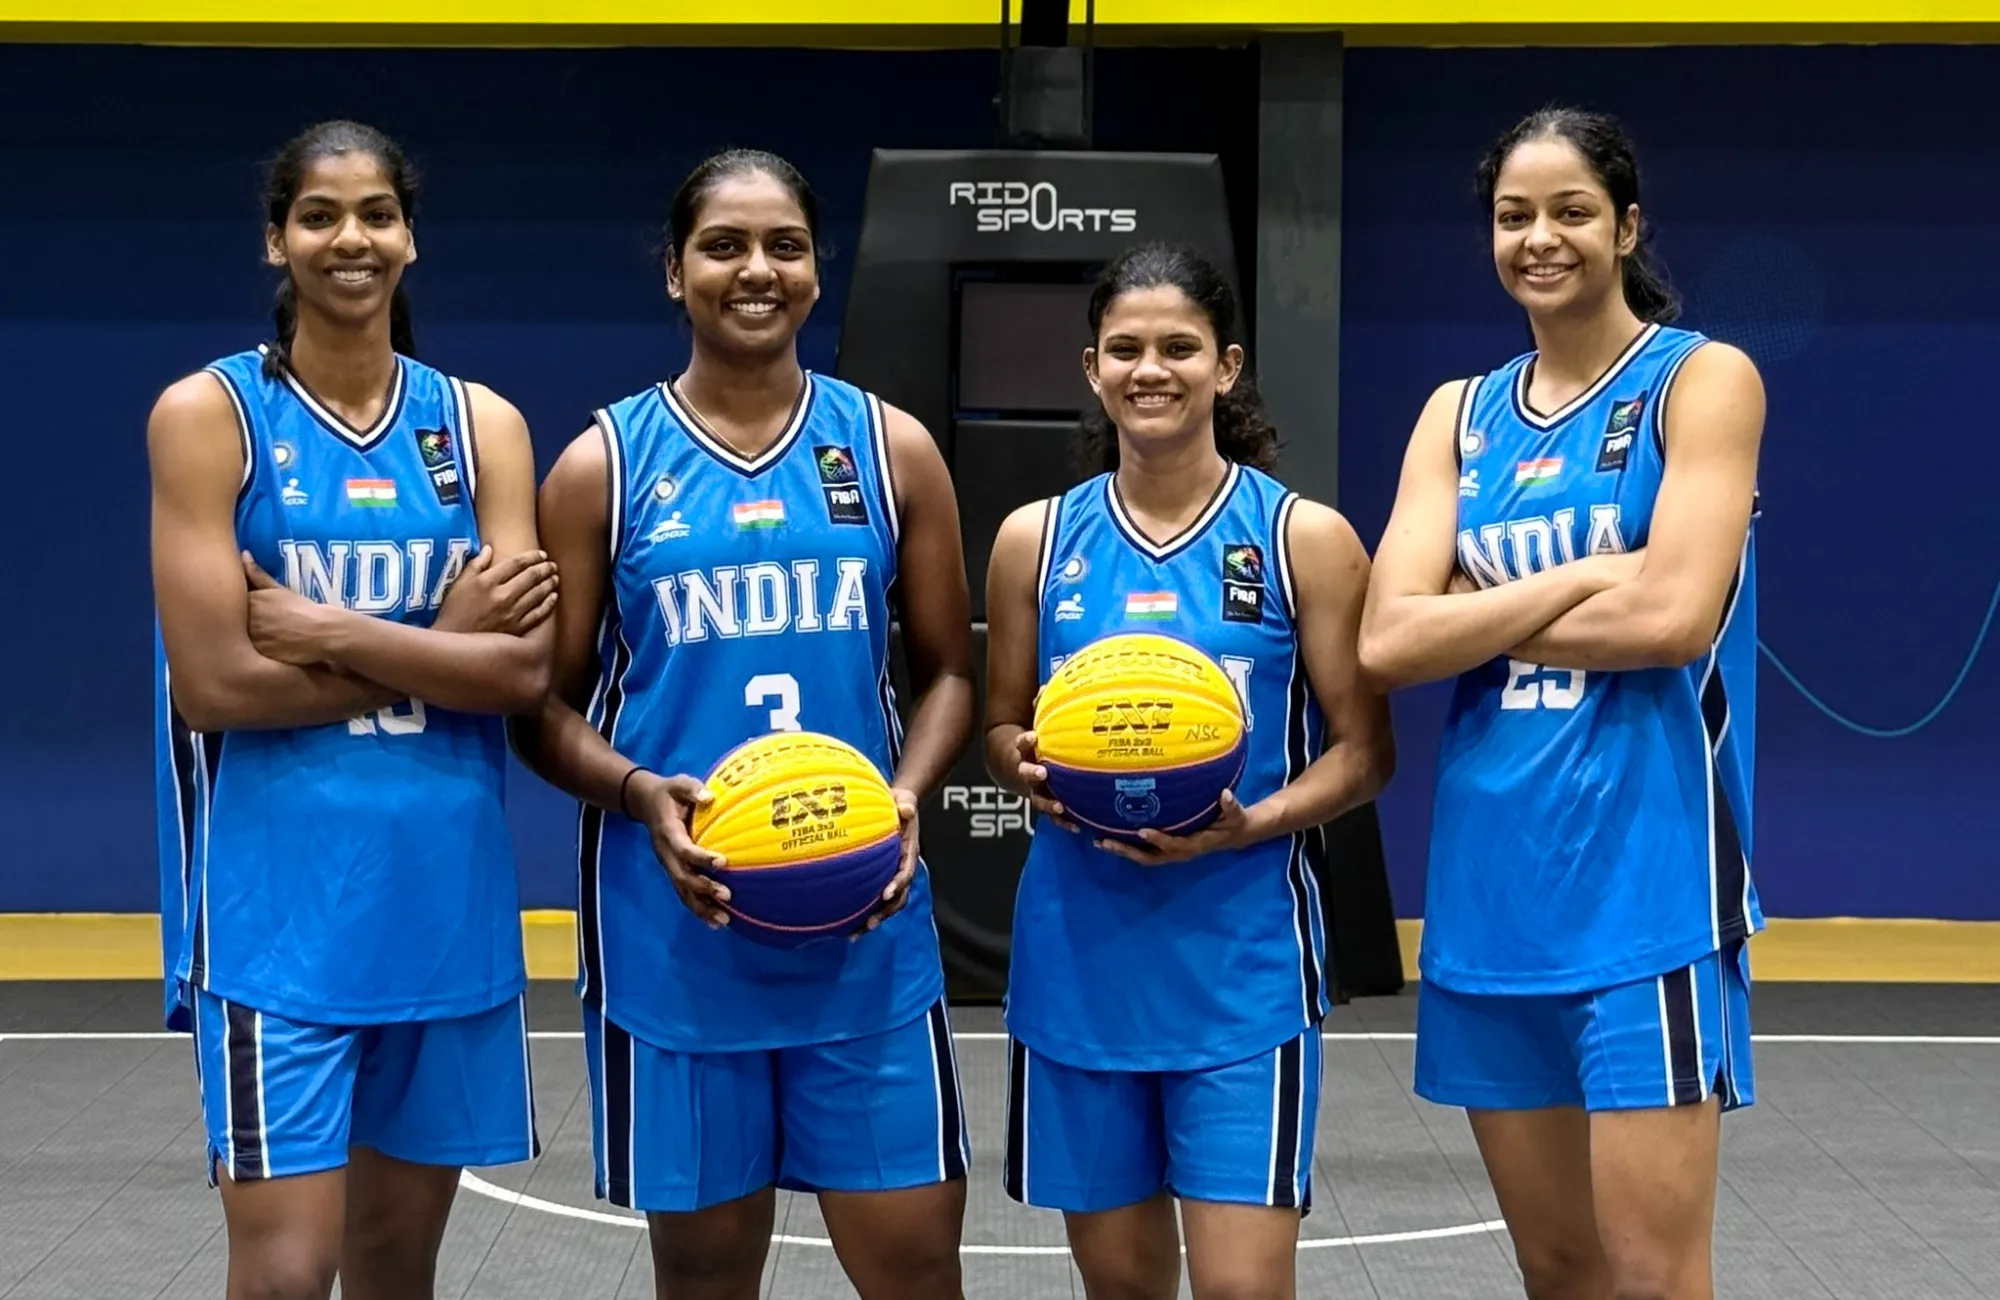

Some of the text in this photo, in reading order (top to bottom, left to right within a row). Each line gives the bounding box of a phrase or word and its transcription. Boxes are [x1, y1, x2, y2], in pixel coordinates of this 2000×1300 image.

[830, 489, 860, 505] FIBA
[278, 538, 471, 614] INDIA
[1457, 504, 1627, 590] NDIA
[651, 557, 869, 648] INDIA
[744, 673, 803, 742] 3
[792, 825, 815, 837] FIBA
